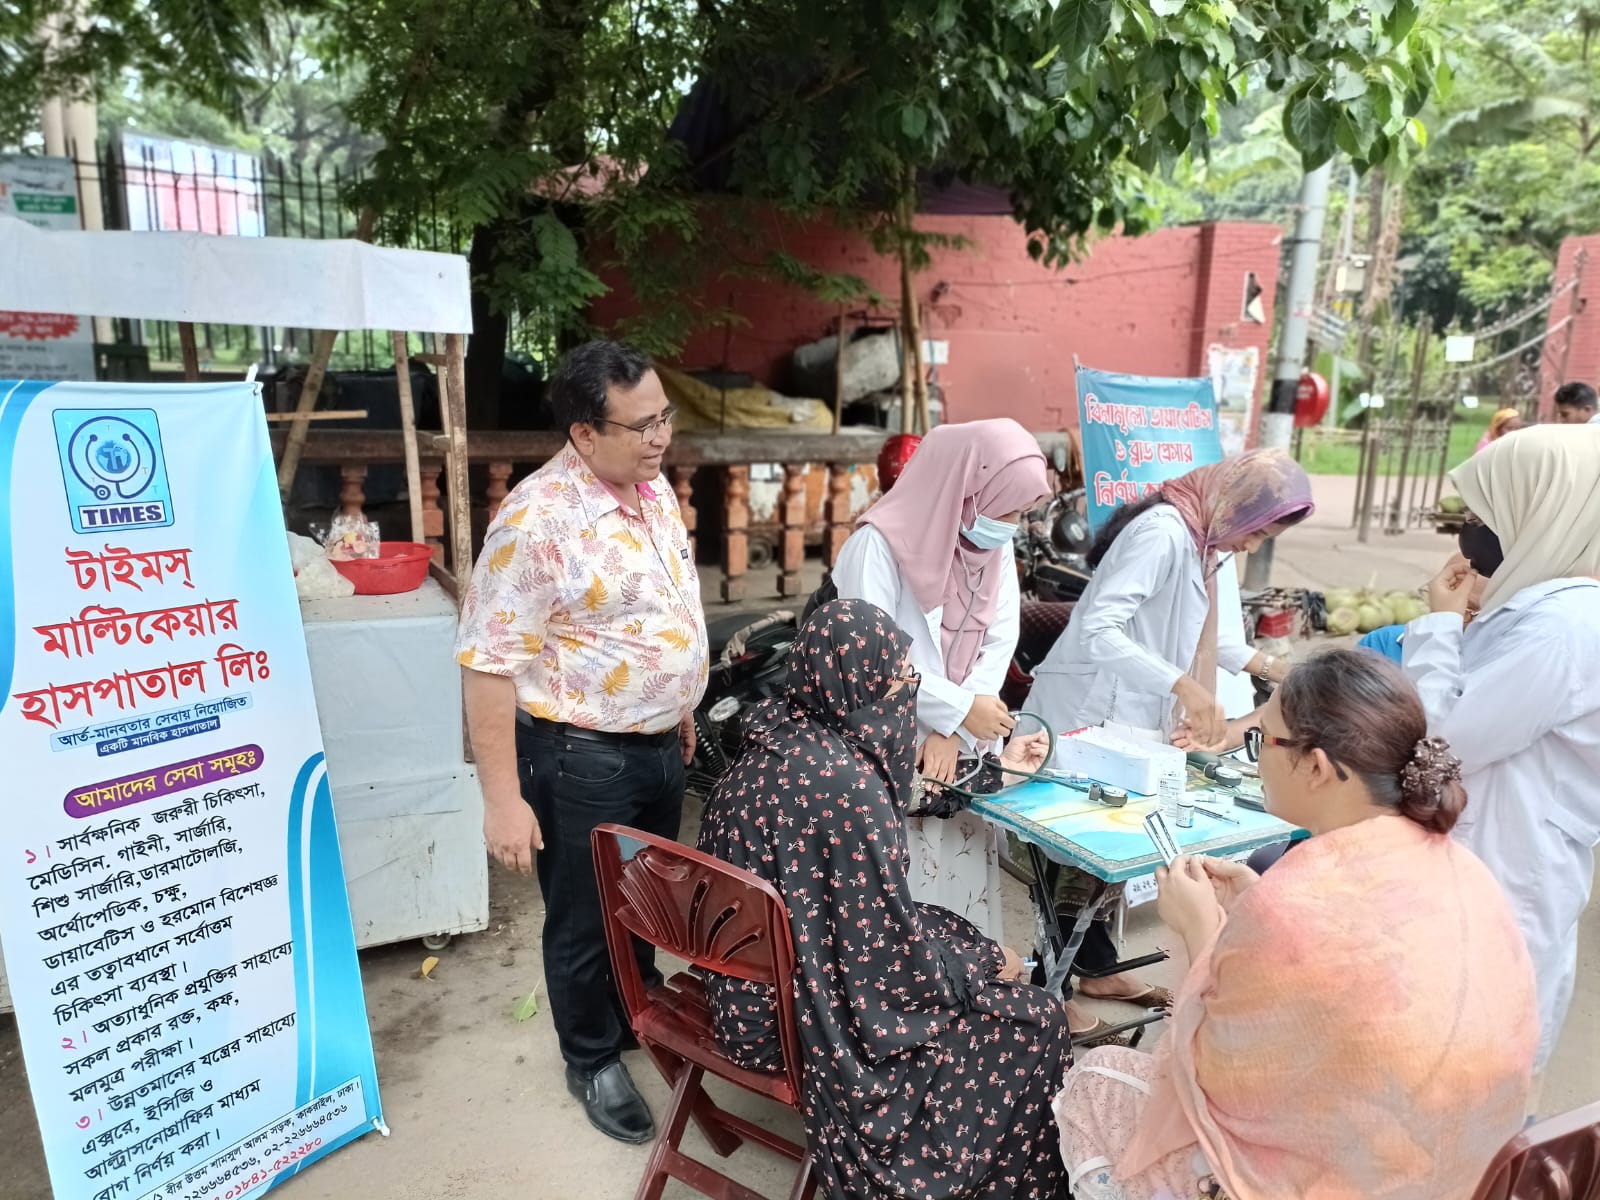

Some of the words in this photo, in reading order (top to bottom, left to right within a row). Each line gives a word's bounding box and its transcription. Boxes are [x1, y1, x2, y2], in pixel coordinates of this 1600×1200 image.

[1115, 440, 1126, 461] ও
[83, 505, 162, 526] TIMES
[65, 543, 195, 592] টাইমস্
[32, 598, 239, 659] মাল্টিকেয়ার
[12, 660, 207, 729] হাসপাতাল
[213, 643, 270, 688] লিঃ
[58, 717, 151, 747] আর্ত-মানবতার
[156, 708, 192, 727] সেবায়
[194, 696, 248, 718] নিয়োজিত
[100, 737, 129, 753] একটি
[131, 731, 168, 748] মানবিক
[171, 718, 218, 738] হাসপাতাল
[74, 775, 157, 809] আমাদের
[164, 762, 203, 787] সেবা
[208, 749, 257, 775] সমূহঃ
[151, 798, 199, 824] জরুরী
[202, 782, 265, 811] চিকিৎসা,
[117, 833, 170, 862] গাইনী,
[173, 815, 232, 843] সার্জারি,
[31, 894, 69, 918] শিশু
[37, 897, 148, 942] অর্থোপেডিক,
[152, 884, 187, 904] চক্ষু,
[42, 926, 135, 970] ডায়াবেটিস
[140, 920, 154, 933] ও
[158, 897, 216, 927] হরমোন
[219, 874, 278, 906] বিশেষজ্ঞ
[51, 975, 80, 996] এর
[173, 916, 233, 946] সর্বোত্তম
[52, 985, 124, 1025] চিকিৎসা
[91, 989, 179, 1033] অত্যাধুনিক
[185, 964, 238, 995] প্রযুক্তির
[240, 940, 294, 970] সাহায্যে
[63, 1046, 111, 1075] সকল
[116, 1023, 162, 1053] প্রকার
[166, 1008, 202, 1031] রক্ত,
[204, 992, 239, 1012] কফ,
[107, 1060, 196, 1112] উন্নতমানের
[199, 1038, 241, 1066] যন্ত্রের
[244, 1012, 296, 1044] সাহায্যে
[82, 1119, 140, 1155] এক্সরে,
[143, 1087, 195, 1120] ইসিজি
[200, 1080, 213, 1092] ও
[216, 1079, 261, 1108] মাধ্যম
[243, 1131, 269, 1149] আলম
[134, 1151, 175, 1184] নির্ণয়
